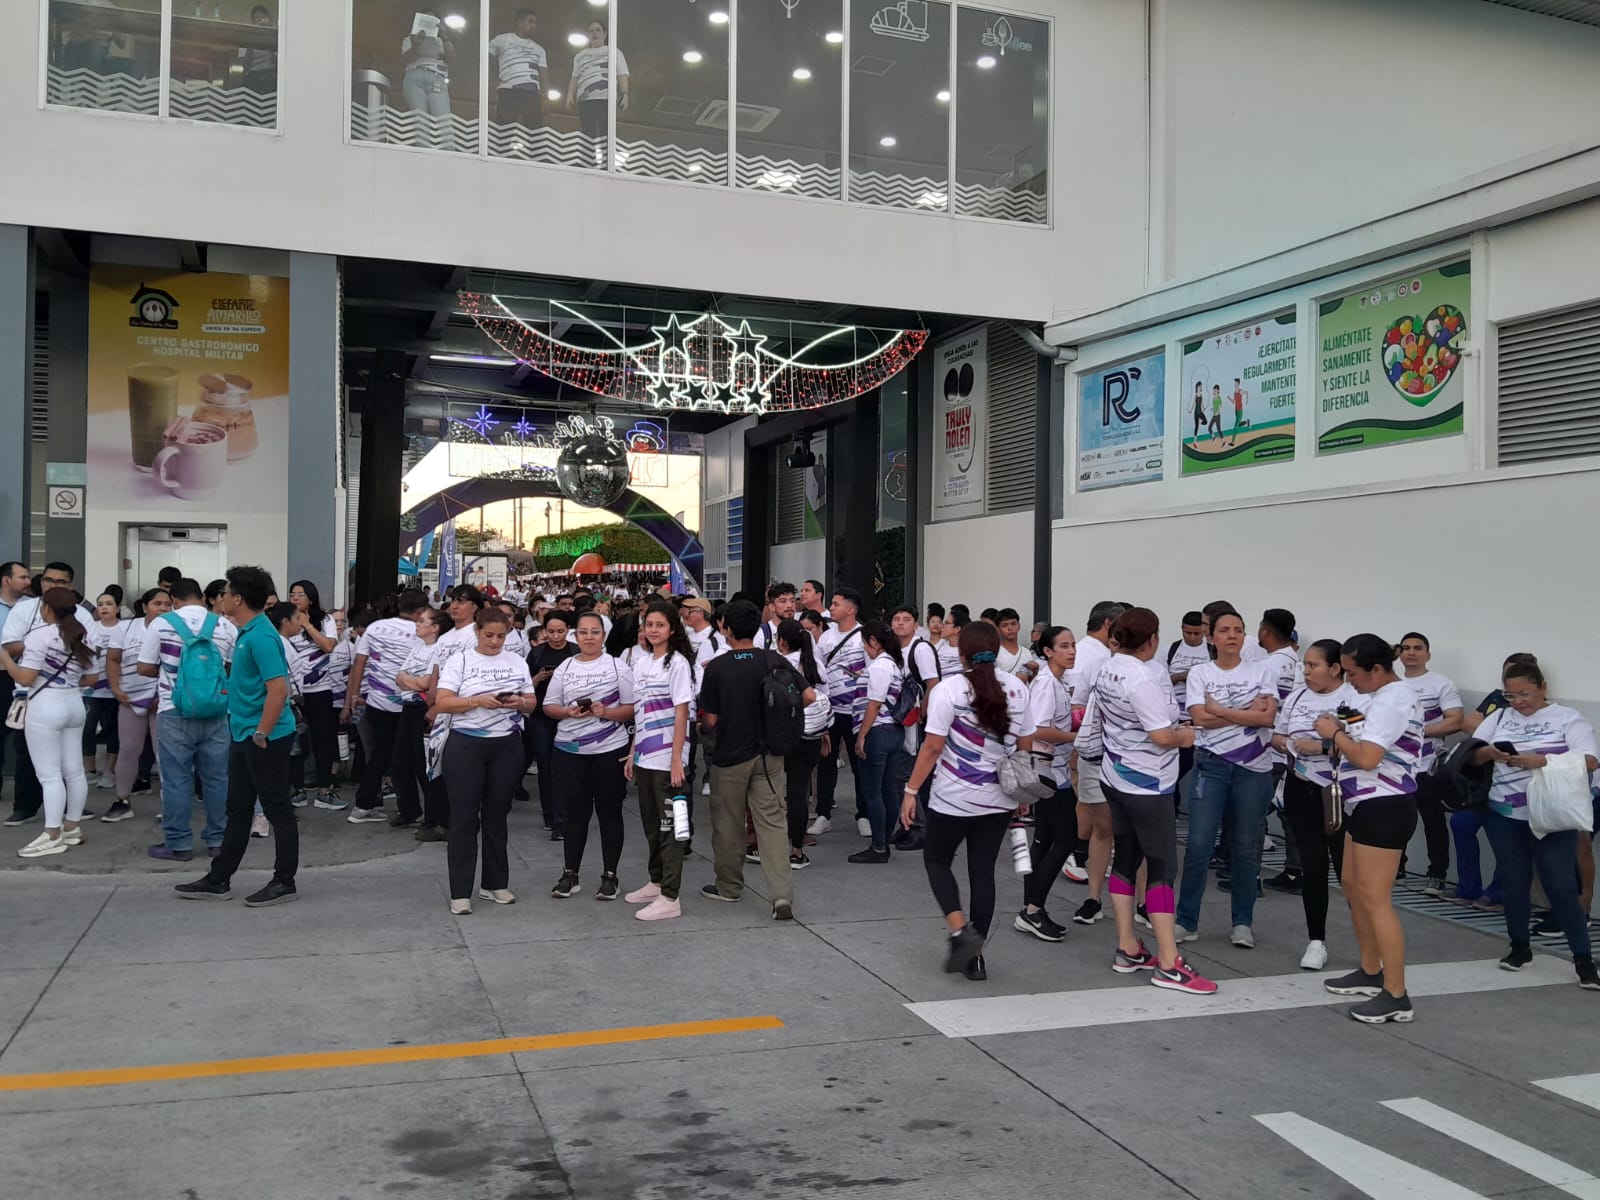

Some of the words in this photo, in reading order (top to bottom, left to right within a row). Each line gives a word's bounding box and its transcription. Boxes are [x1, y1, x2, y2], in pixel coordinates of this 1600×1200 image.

[211, 299, 256, 310] ELEFANTE
[137, 336, 177, 347] CENTRO
[1323, 327, 1372, 353] ALIMÉNTATE
[153, 347, 201, 359] HOSPITAL
[205, 350, 244, 361] MILITAR
[1323, 348, 1372, 373] SANAMENTE
[1244, 355, 1296, 380] REGULARMENTE
[1323, 378, 1329, 392] Y
[1330, 371, 1358, 392] SIENTE
[1360, 369, 1371, 385] LA
[1323, 391, 1369, 413] DIFERENCIA
[946, 405, 972, 430] TRULY
[946, 426, 971, 450] NOLEN
